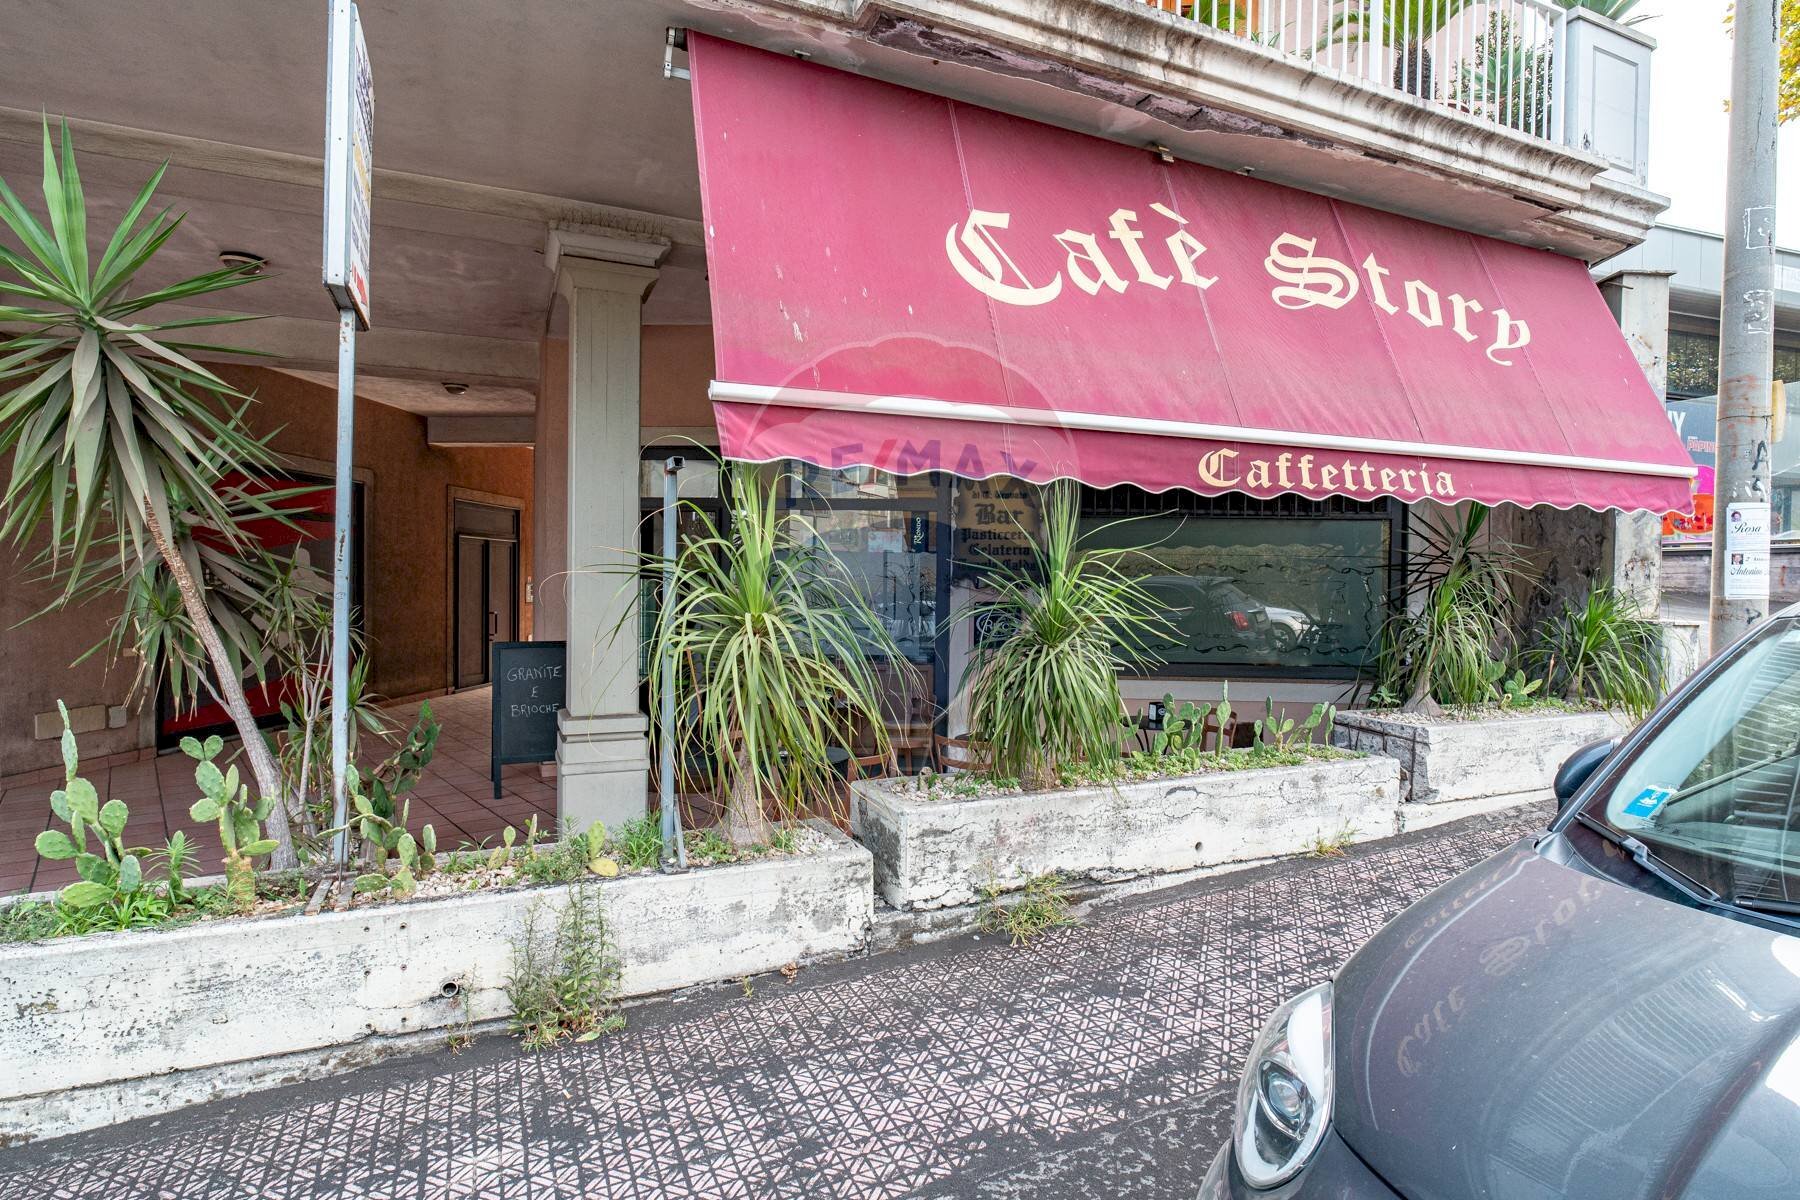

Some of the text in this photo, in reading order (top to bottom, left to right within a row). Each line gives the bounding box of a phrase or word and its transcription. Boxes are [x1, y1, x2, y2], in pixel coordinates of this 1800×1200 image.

[946, 202, 1531, 367] Cafè Story
[1198, 447, 1457, 496] Caffetteria
[975, 503, 1024, 525] Bar
[1733, 521, 1762, 534] Rosa
[968, 543, 1030, 556] Gelateria
[507, 664, 563, 682] GRANITE
[530, 686, 539, 698] E
[511, 703, 560, 718] BRIOCHE
